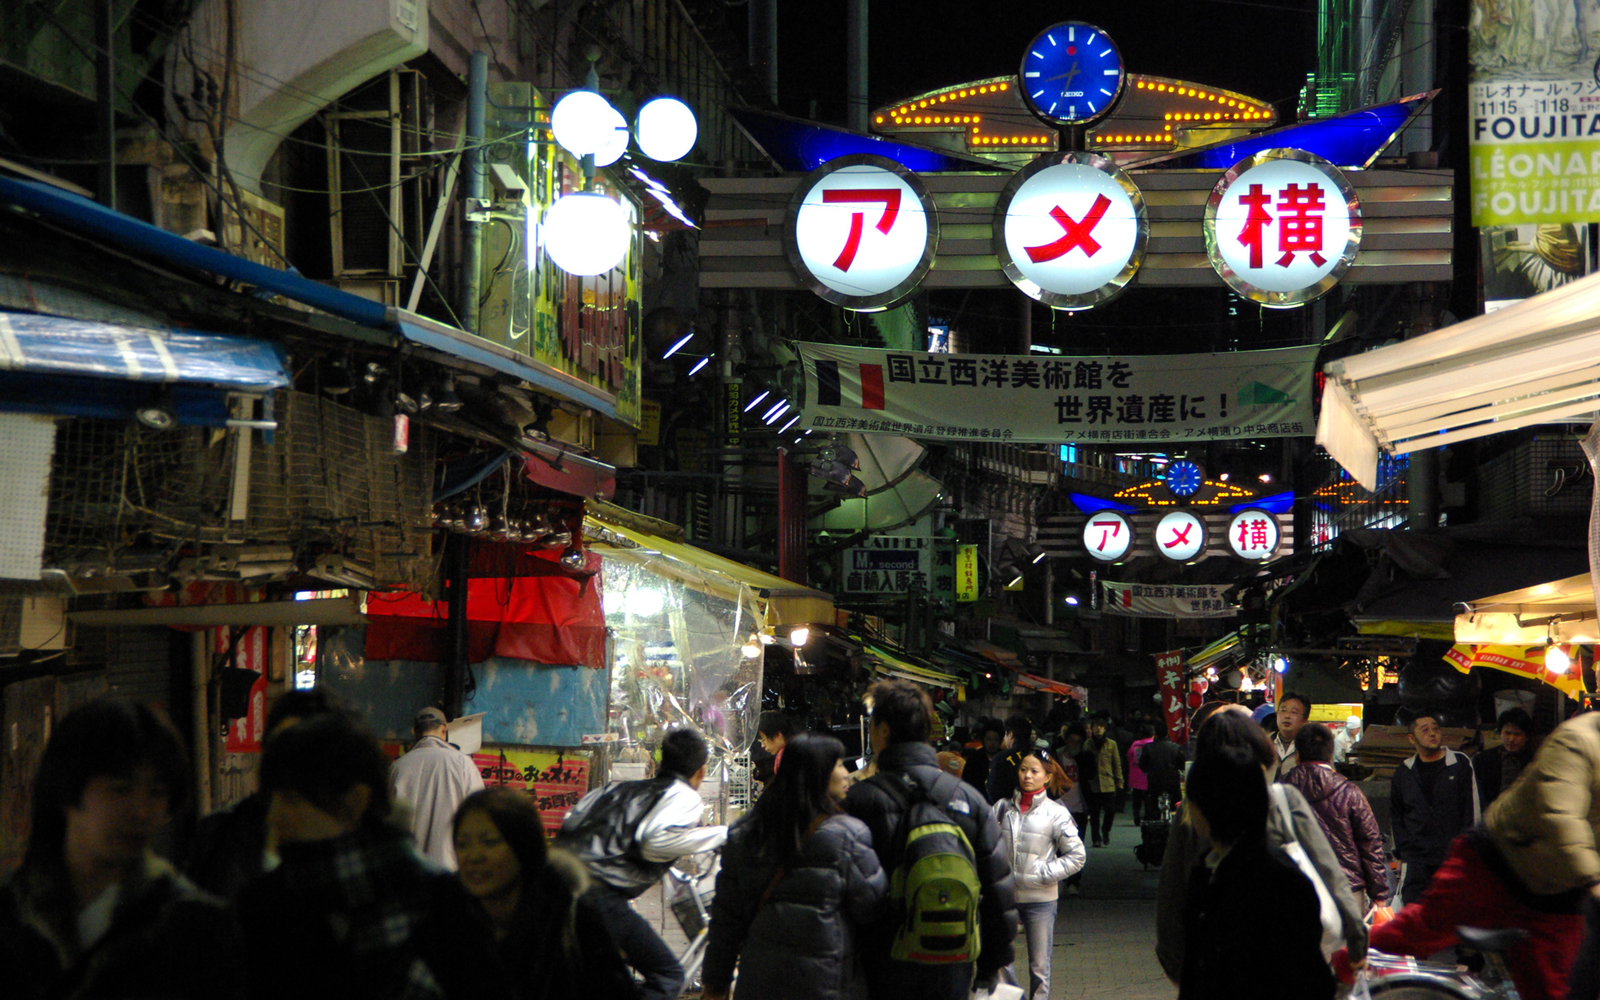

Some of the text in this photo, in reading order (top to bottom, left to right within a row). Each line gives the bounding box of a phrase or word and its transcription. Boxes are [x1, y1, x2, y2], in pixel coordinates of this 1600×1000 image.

[1474, 114, 1600, 141] FOUJITA
[1474, 189, 1600, 217] FOUJITA
[886, 353, 1134, 391] 国立西洋美術館を
[1093, 519, 1269, 551] アメ横
[879, 560, 915, 569] second
[1132, 585, 1218, 599] 国立西洋美術館を
[1163, 670, 1186, 736] キムチ
